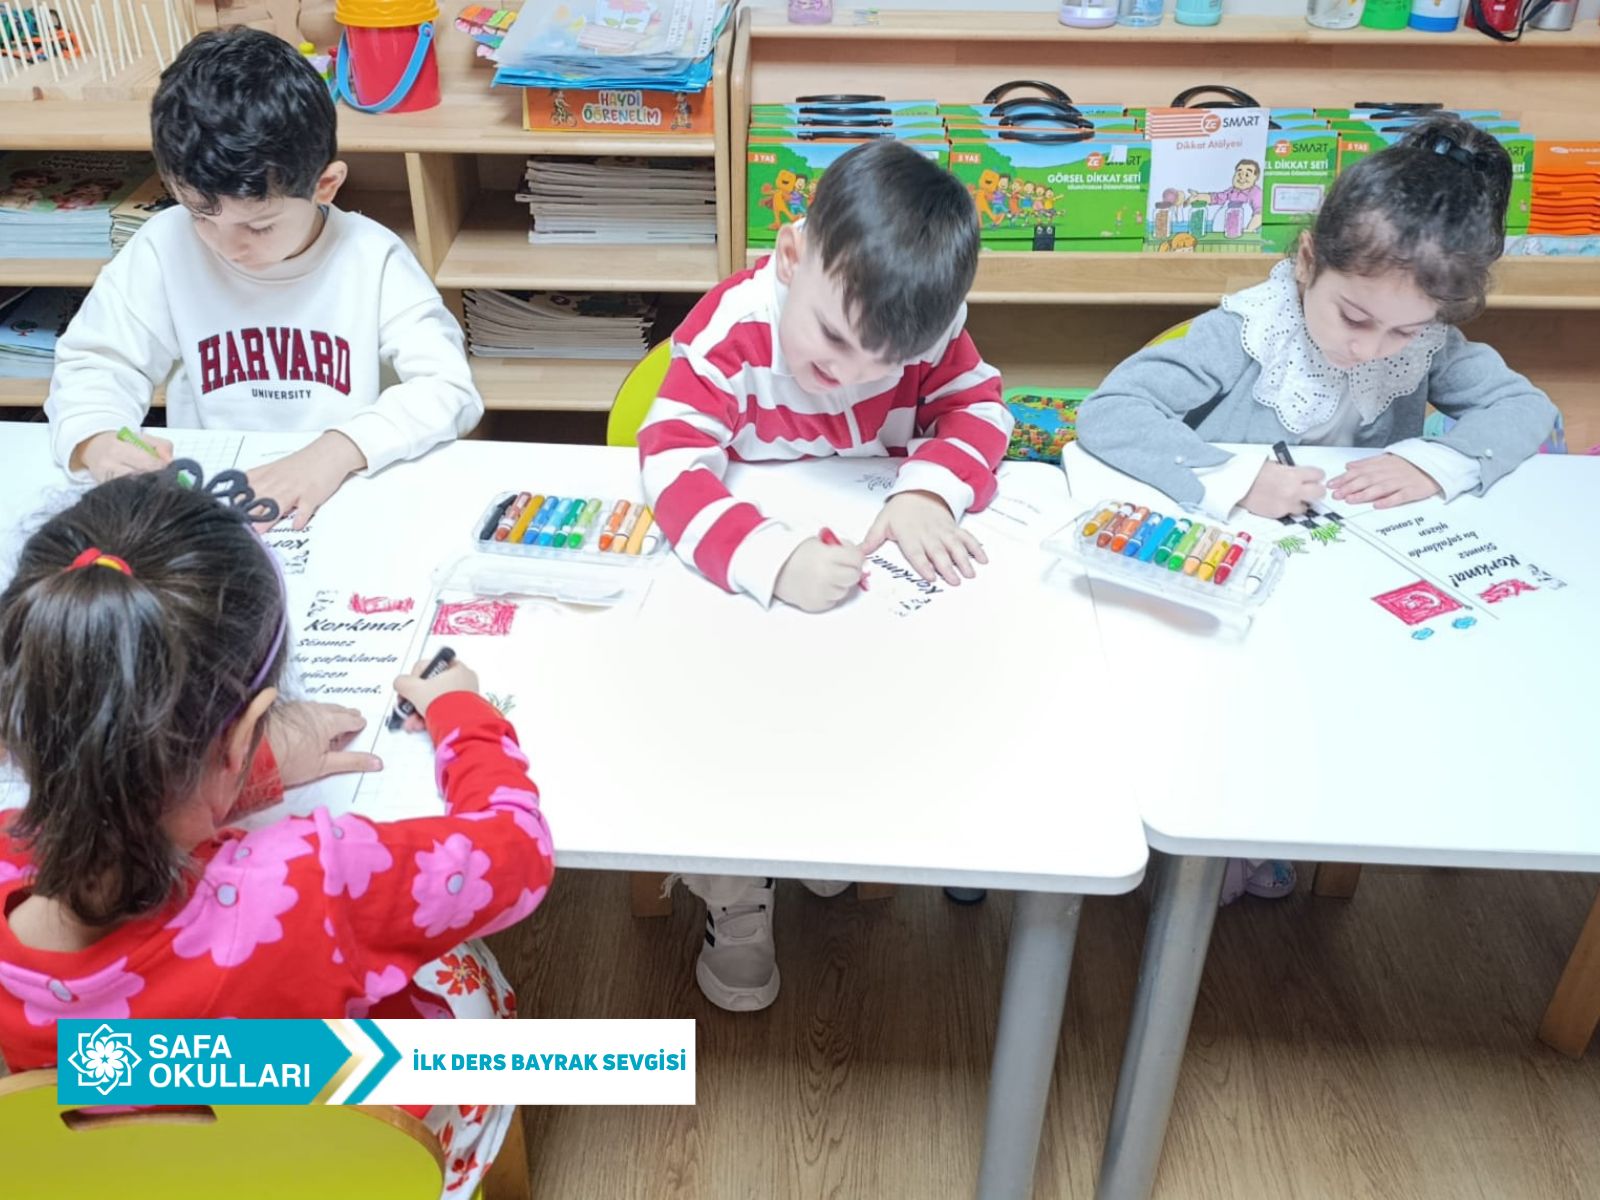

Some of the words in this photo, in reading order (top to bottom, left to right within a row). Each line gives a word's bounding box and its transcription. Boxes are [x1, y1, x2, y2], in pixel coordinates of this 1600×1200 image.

[583, 105, 660, 123] ÖĞRENELİM
[1223, 115, 1260, 128] SMART
[1176, 142, 1206, 150] Dikkat
[1207, 139, 1243, 150] Atölyesi
[1292, 143, 1328, 153] SMART
[1274, 159, 1308, 169] DİKKAT
[1310, 159, 1328, 169] SETİ
[1047, 172, 1084, 183] GÖRSEL
[1087, 172, 1121, 183] DİKKAT
[1122, 171, 1141, 183] SETİ
[198, 326, 352, 396] HARVARD
[251, 388, 312, 400] UNIVERSITY
[1448, 553, 1521, 588] Korkma!
[303, 618, 415, 632] Korkma!
